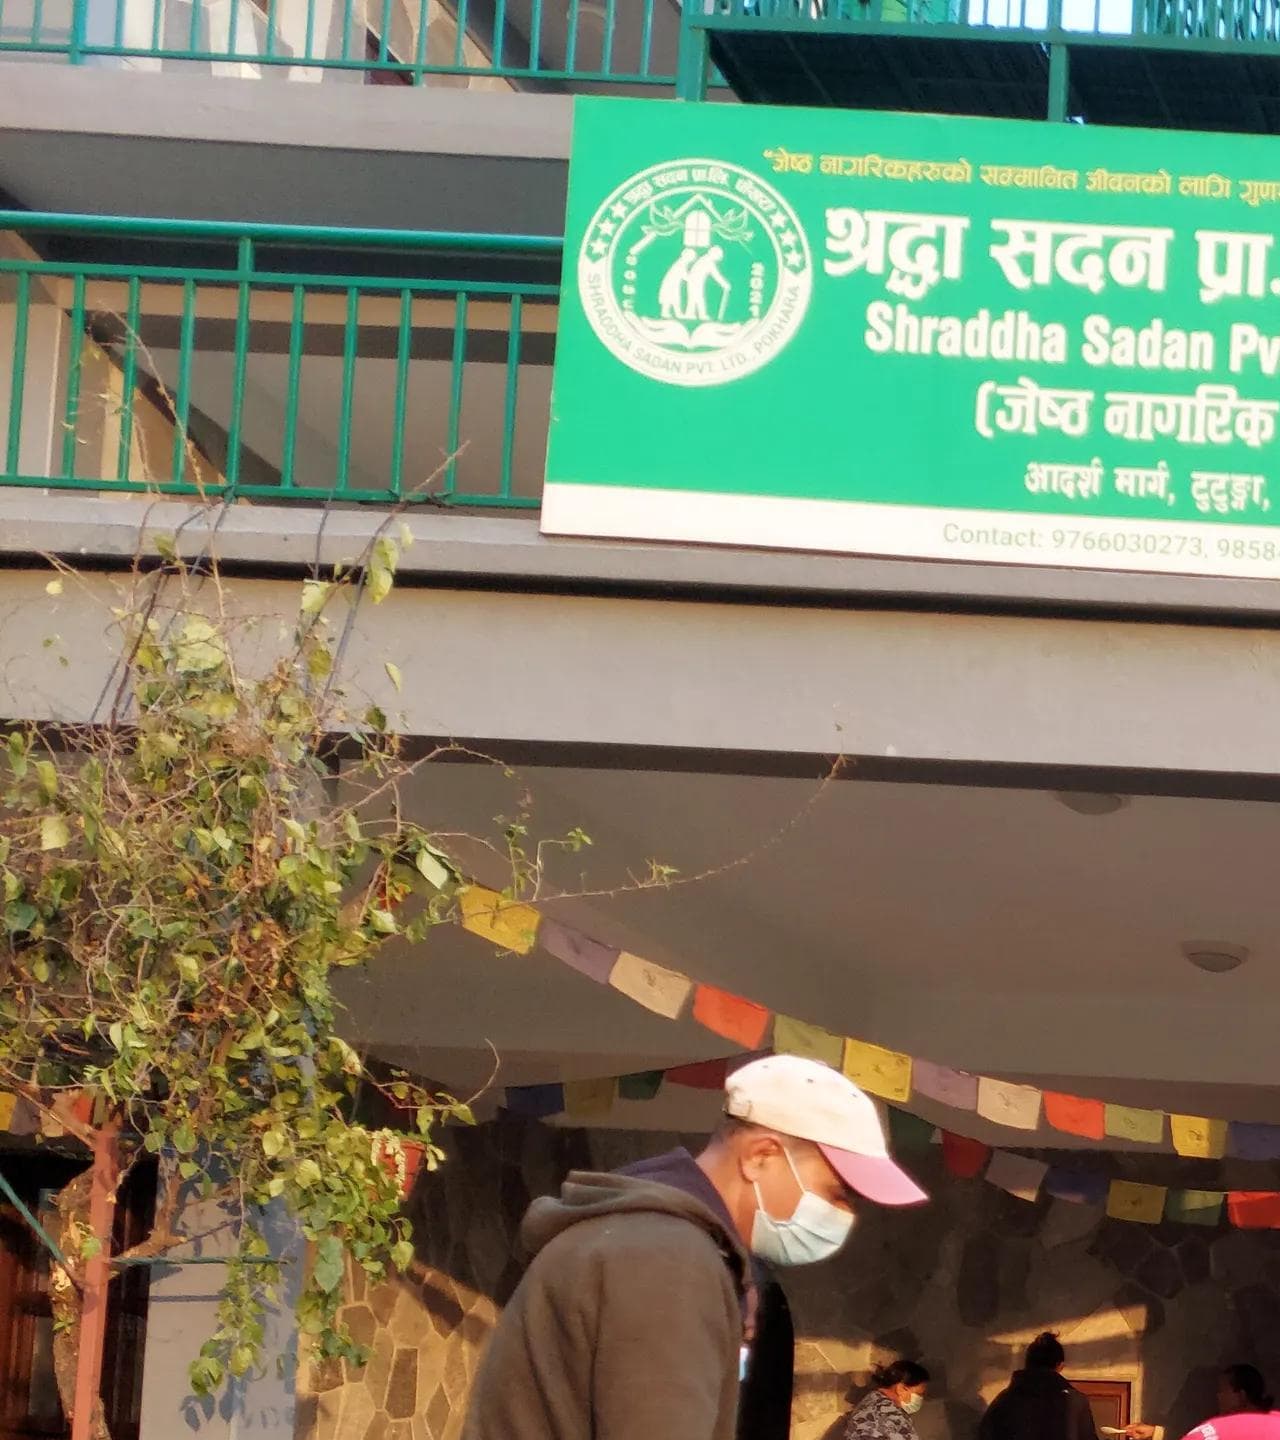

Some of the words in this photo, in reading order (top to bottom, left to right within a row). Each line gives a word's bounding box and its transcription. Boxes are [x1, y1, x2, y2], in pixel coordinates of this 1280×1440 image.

[989, 217, 1174, 291] सदन
[864, 300, 1067, 363] Shraddha
[1081, 314, 1214, 372] Sadan
[1104, 384, 1280, 447] नागरिक
[1023, 457, 1104, 499] आदर्श
[942, 522, 1043, 549] Contact:
